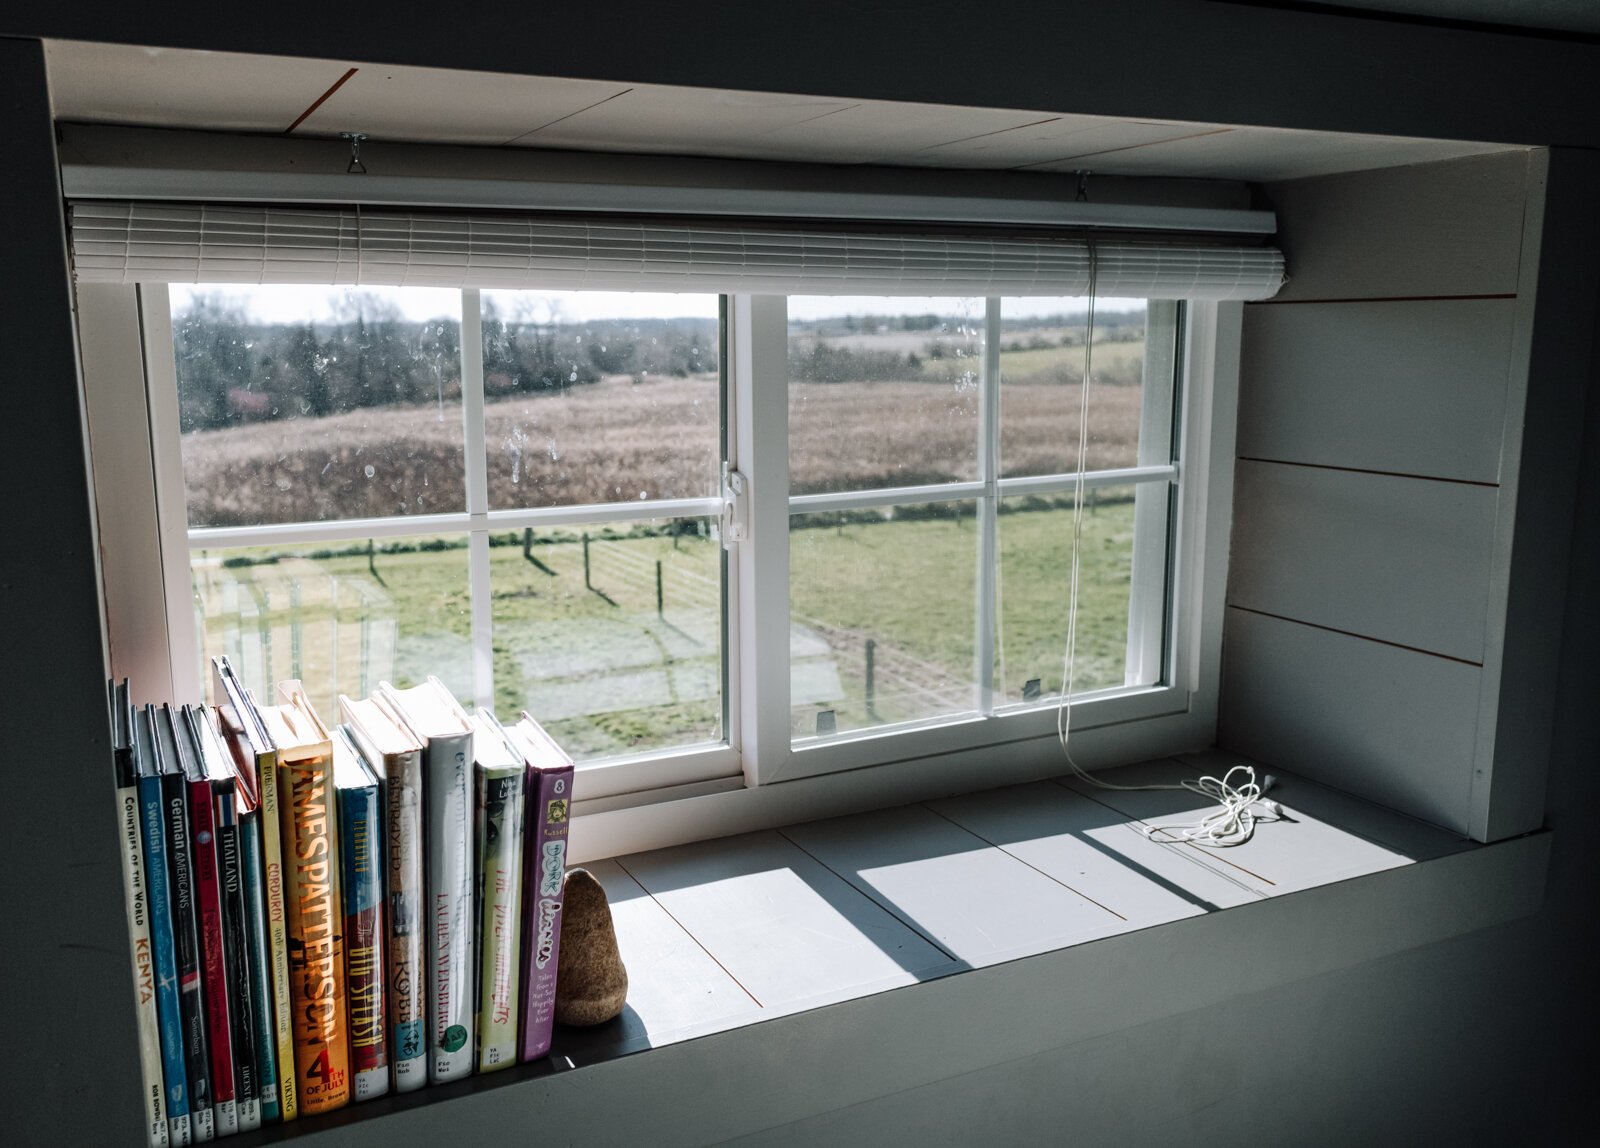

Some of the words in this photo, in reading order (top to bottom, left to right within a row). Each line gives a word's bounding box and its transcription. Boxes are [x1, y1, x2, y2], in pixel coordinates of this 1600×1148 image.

[263, 765, 275, 813] FREEMAN
[284, 755, 329, 860] JAMES
[124, 796, 138, 850] COUNTRIES
[147, 801, 161, 854] Swedish
[171, 797, 185, 850] German
[389, 775, 402, 871] BETRAYED
[543, 826, 568, 837] Russell
[130, 854, 139, 867] OF
[131, 870, 141, 888] THE
[152, 856, 166, 915] AMERICANS
[174, 851, 189, 909] AMERICANS
[222, 830, 237, 892] THAILAND
[495, 868, 511, 894] THE
[544, 843, 563, 894] DORK
[134, 891, 144, 927] WORLD
[268, 863, 282, 923] CORDUROY
[274, 927, 283, 946] 40th
[436, 893, 449, 951] LAUREN
[135, 937, 152, 1006] KENYA
[275, 949, 286, 999] Anniversary
[297, 861, 337, 1046] PATTERSON
[350, 983, 383, 1048] SPLASH
[437, 953, 449, 1048] WEISBERGE
[190, 1015, 201, 1056] Sonneborn
[242, 1065, 252, 1096] LUCENT
[284, 1077, 294, 1112] VIKING
[306, 1085, 320, 1095] OF
[322, 1078, 344, 1093] JULY
